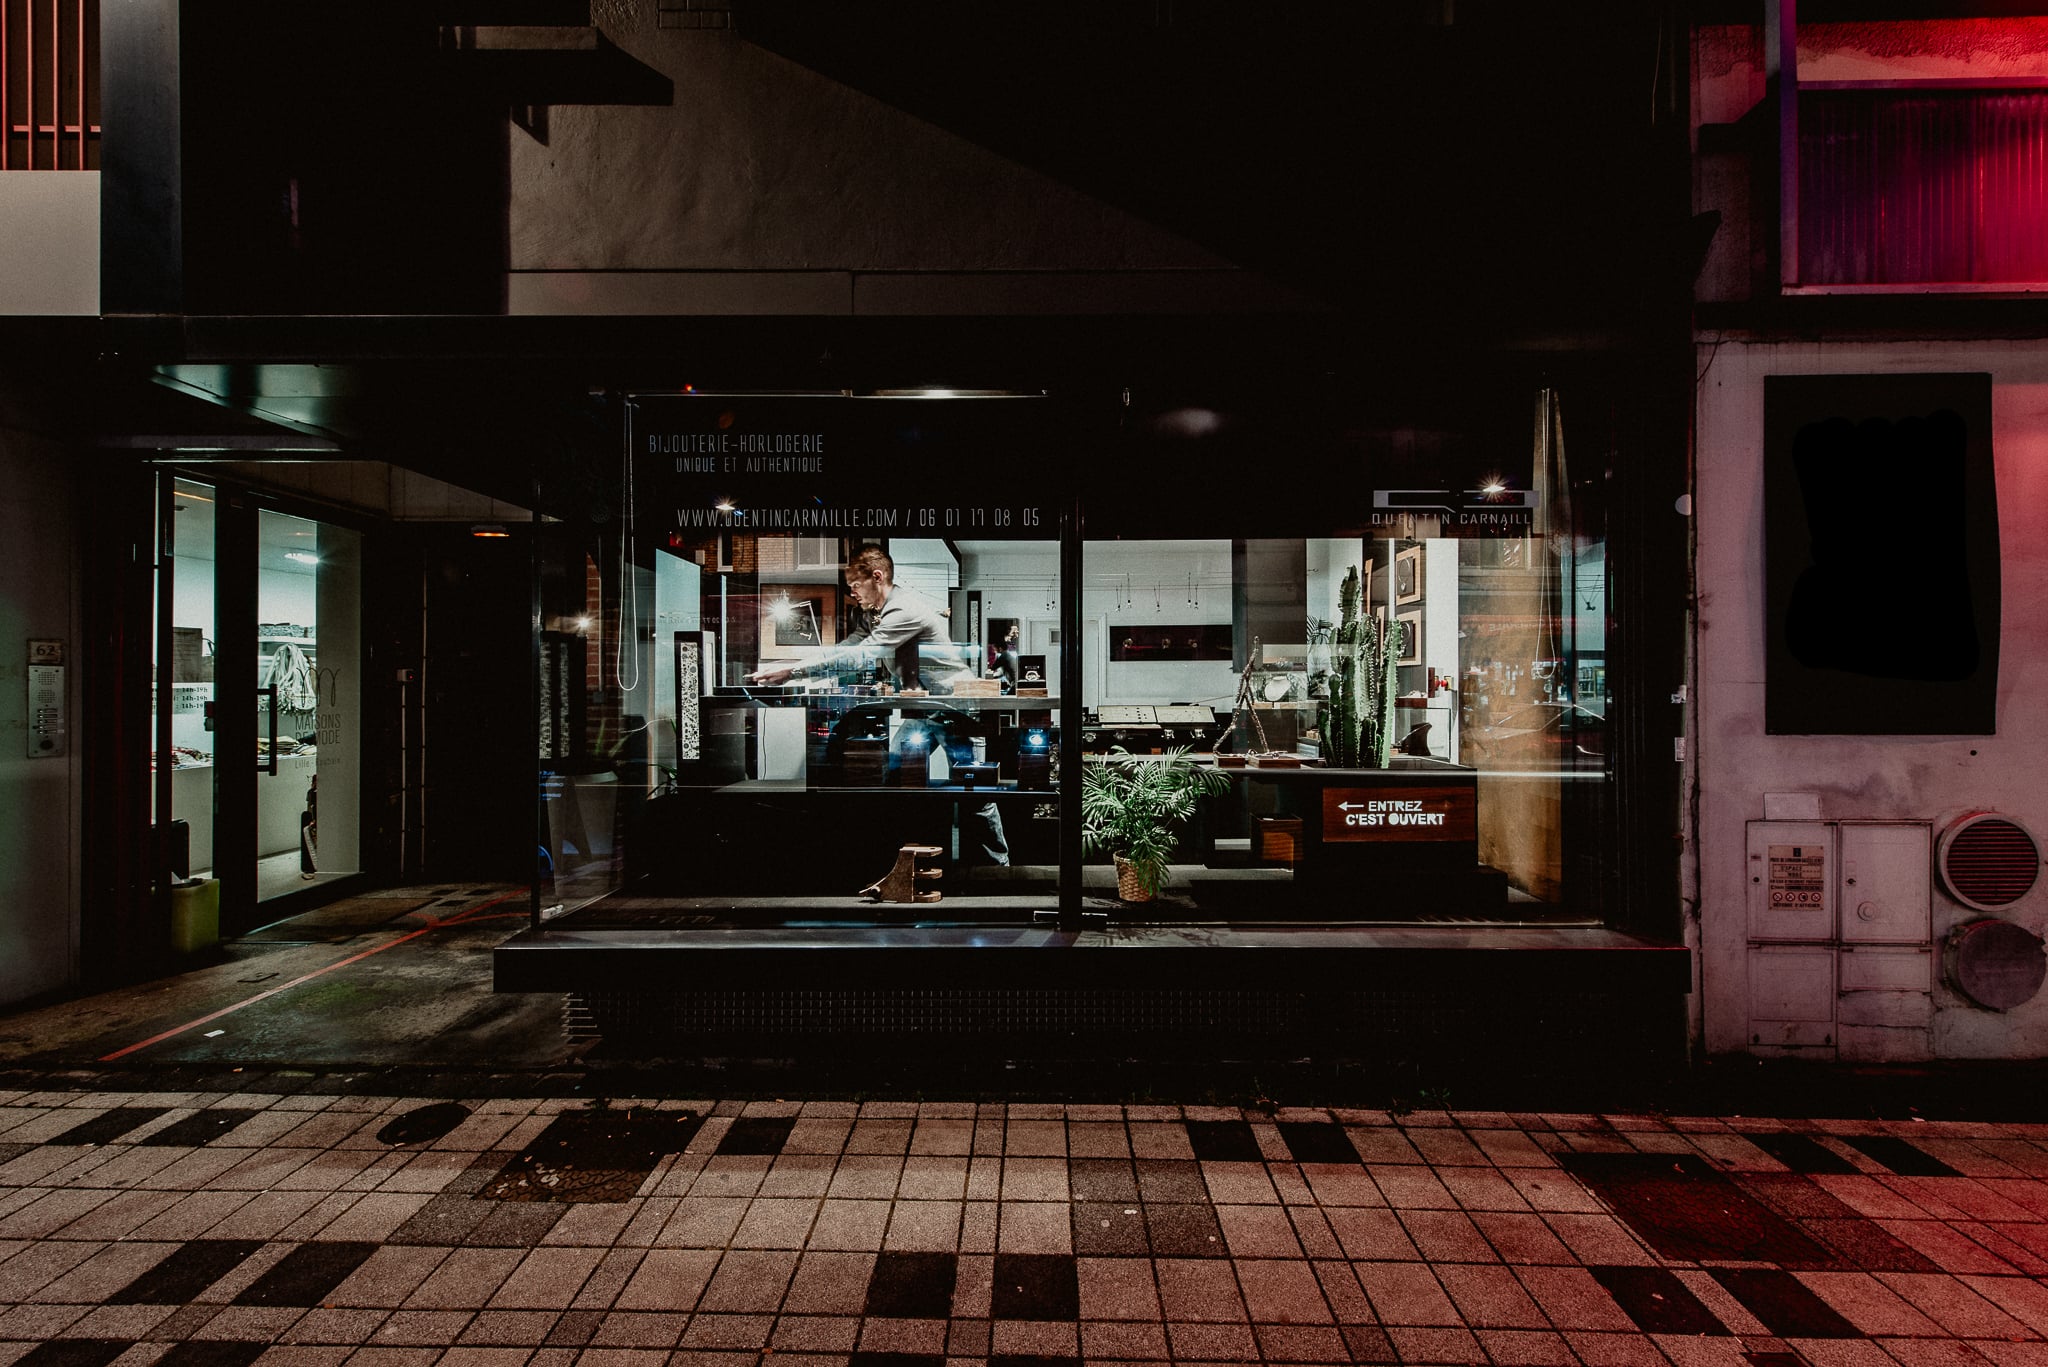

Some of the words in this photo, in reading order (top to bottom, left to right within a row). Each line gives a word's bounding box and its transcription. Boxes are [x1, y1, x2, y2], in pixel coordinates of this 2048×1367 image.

[649, 434, 824, 453] BIJOUTERIE-HORLOGERIE
[676, 457, 716, 473] UNIQUE
[724, 457, 737, 473] ET
[746, 457, 823, 473] AUTHENTIQUE
[919, 508, 936, 527] 06
[946, 508, 960, 527] 01
[994, 508, 1011, 527] 08
[1023, 508, 1039, 527] 05
[1372, 513, 1450, 525] QUENTIN
[36, 645, 56, 656] 62
[295, 714, 341, 731] MAISONS
[1368, 801, 1423, 812] ENTREZ
[1345, 813, 1386, 826] C'EST
[1388, 813, 1446, 825] OUVERT
